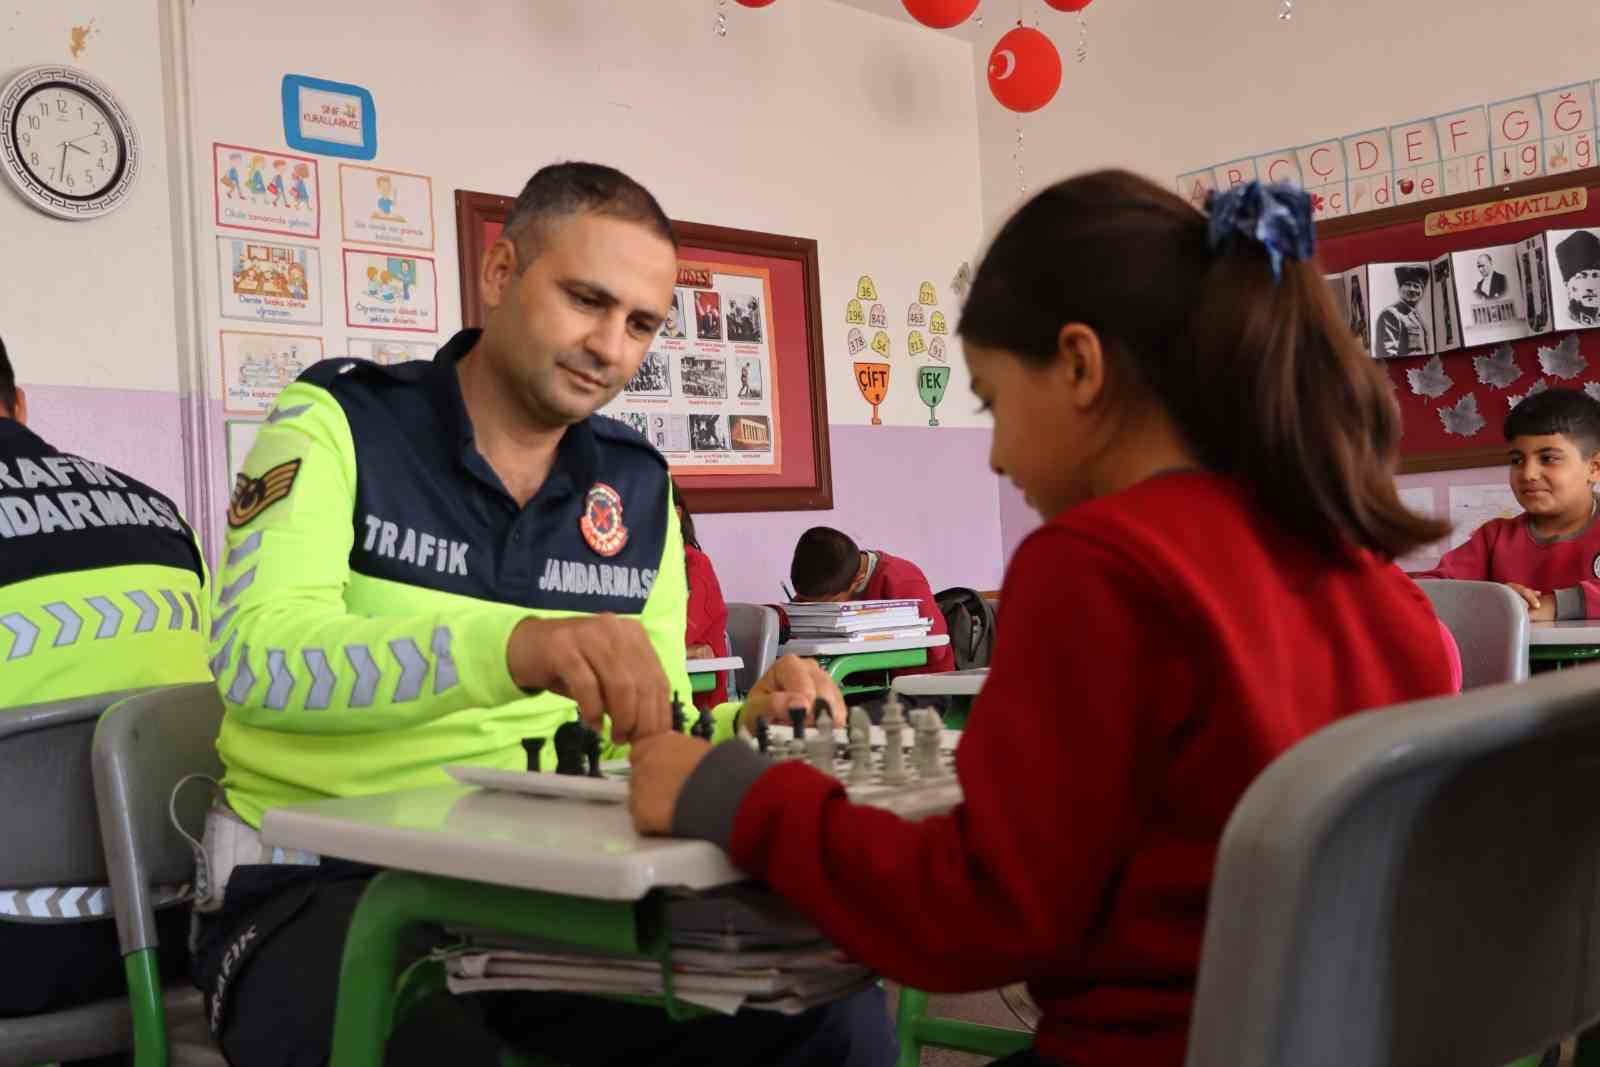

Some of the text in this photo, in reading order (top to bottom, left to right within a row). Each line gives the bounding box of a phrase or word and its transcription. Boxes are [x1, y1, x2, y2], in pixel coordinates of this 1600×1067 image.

[40, 102, 49, 117] 11
[56, 98, 68, 114] 12
[28, 115, 40, 130] 10
[92, 121, 101, 136] 2
[22, 133, 31, 147] 9
[1310, 148, 1335, 182] Ç
[1356, 140, 1379, 171] D
[1406, 130, 1423, 162] E
[1450, 119, 1469, 152] F
[1502, 110, 1529, 141] G
[1554, 92, 1583, 132] Ğ
[100, 139, 109, 154] 3
[31, 152, 39, 166] 8
[97, 157, 105, 171] 4
[48, 167, 56, 181] 7
[66, 173, 75, 187] 6
[84, 169, 93, 184] 5
[1329, 134, 1591, 214] ç d e f g ğ
[1484, 191, 1581, 223] SANATLAR
[859, 367, 887, 391] ÇİFT
[920, 372, 942, 389] TEK
[0, 490, 187, 538] DARMAS
